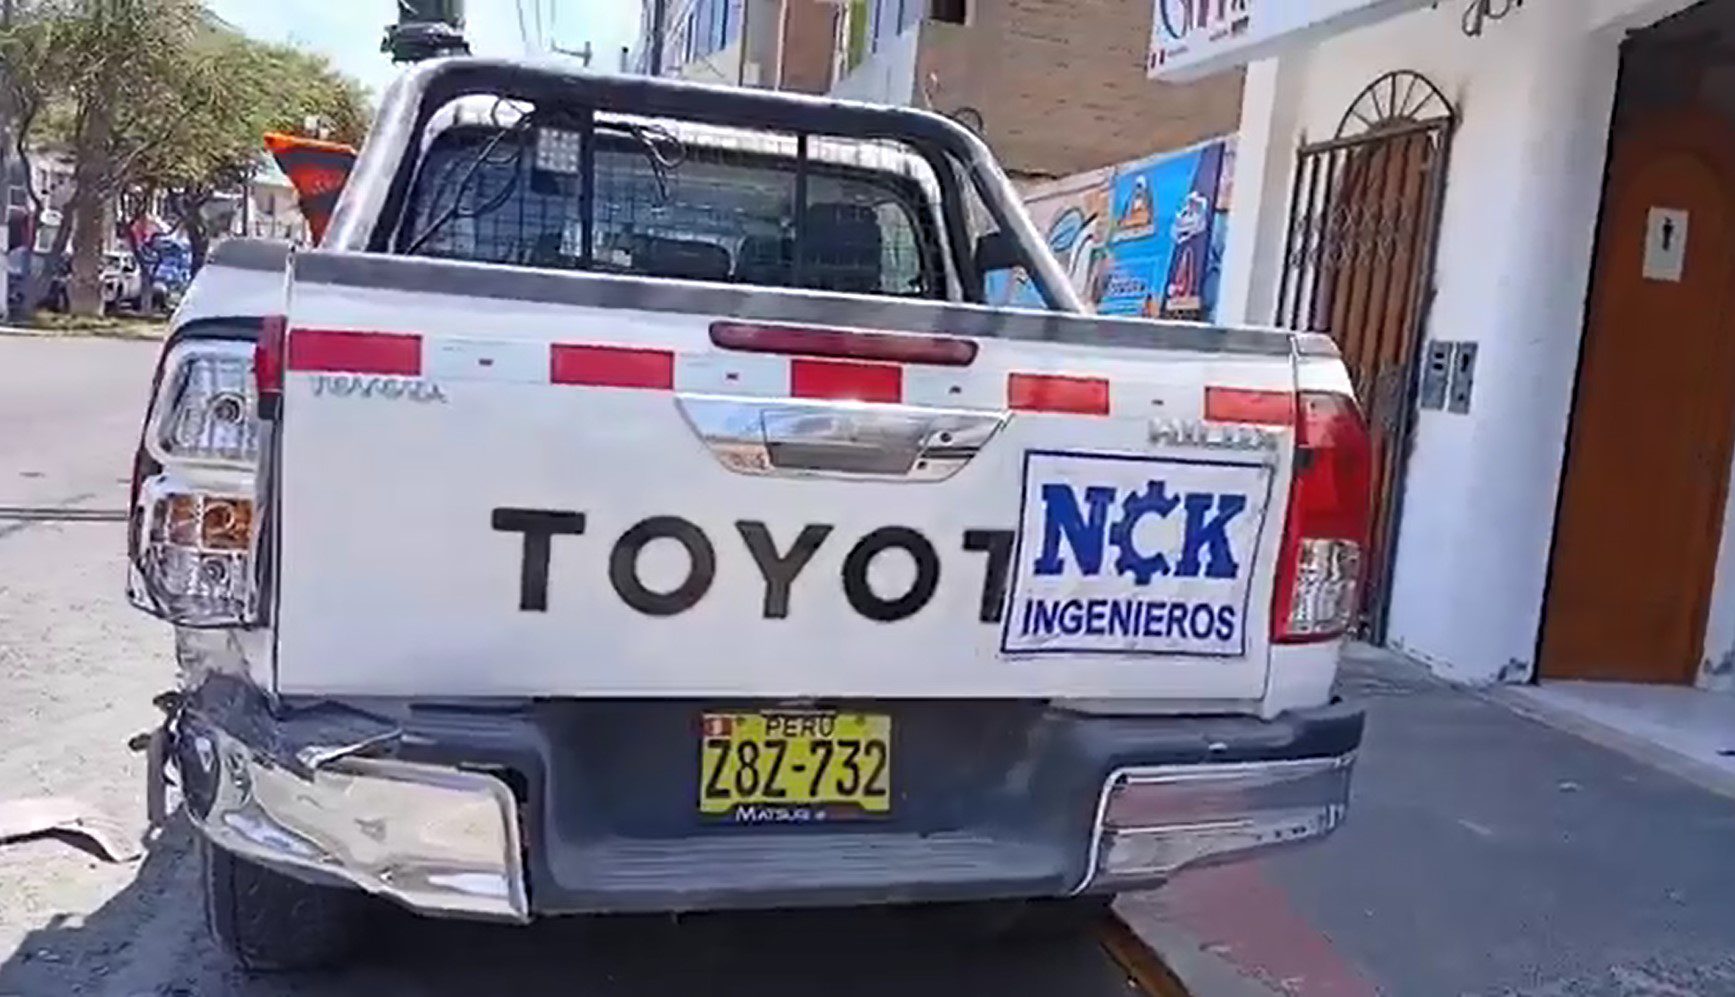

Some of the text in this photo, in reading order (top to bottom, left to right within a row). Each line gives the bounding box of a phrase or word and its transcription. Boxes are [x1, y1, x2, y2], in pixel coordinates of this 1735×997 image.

[1033, 480, 1247, 586] NCK
[1021, 599, 1236, 641] INGENIEROS
[705, 739, 887, 798] Z8Z-732
